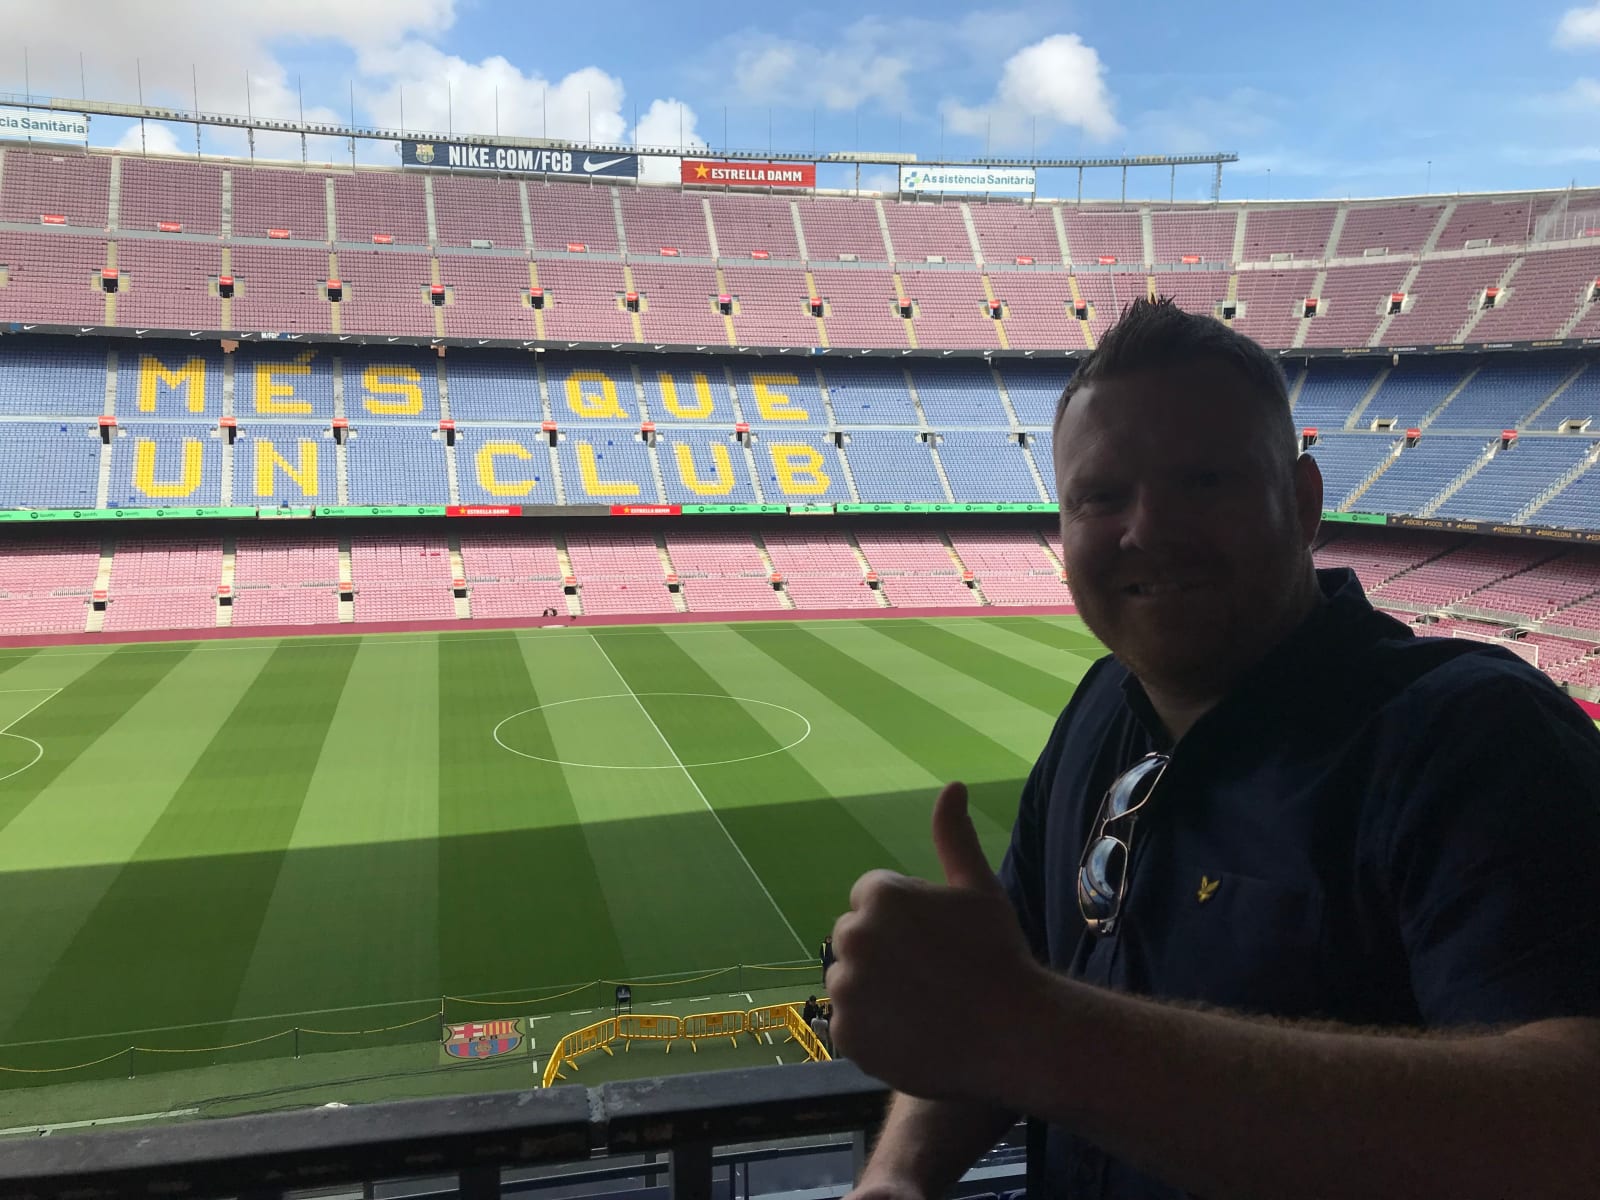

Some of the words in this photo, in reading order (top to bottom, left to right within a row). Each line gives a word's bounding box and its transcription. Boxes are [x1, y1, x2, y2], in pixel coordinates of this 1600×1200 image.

[21, 117, 85, 134] Sanitària
[448, 146, 572, 172] NIKE.COM/FCB
[711, 168, 765, 180] ESTRELLA
[767, 170, 802, 182] DAMM
[922, 173, 986, 185] Assistència
[987, 174, 1035, 185] Sanitària
[137, 350, 424, 416] MÉS
[564, 368, 809, 421] QUE
[132, 437, 319, 498] UN
[474, 439, 831, 498] CLUB
